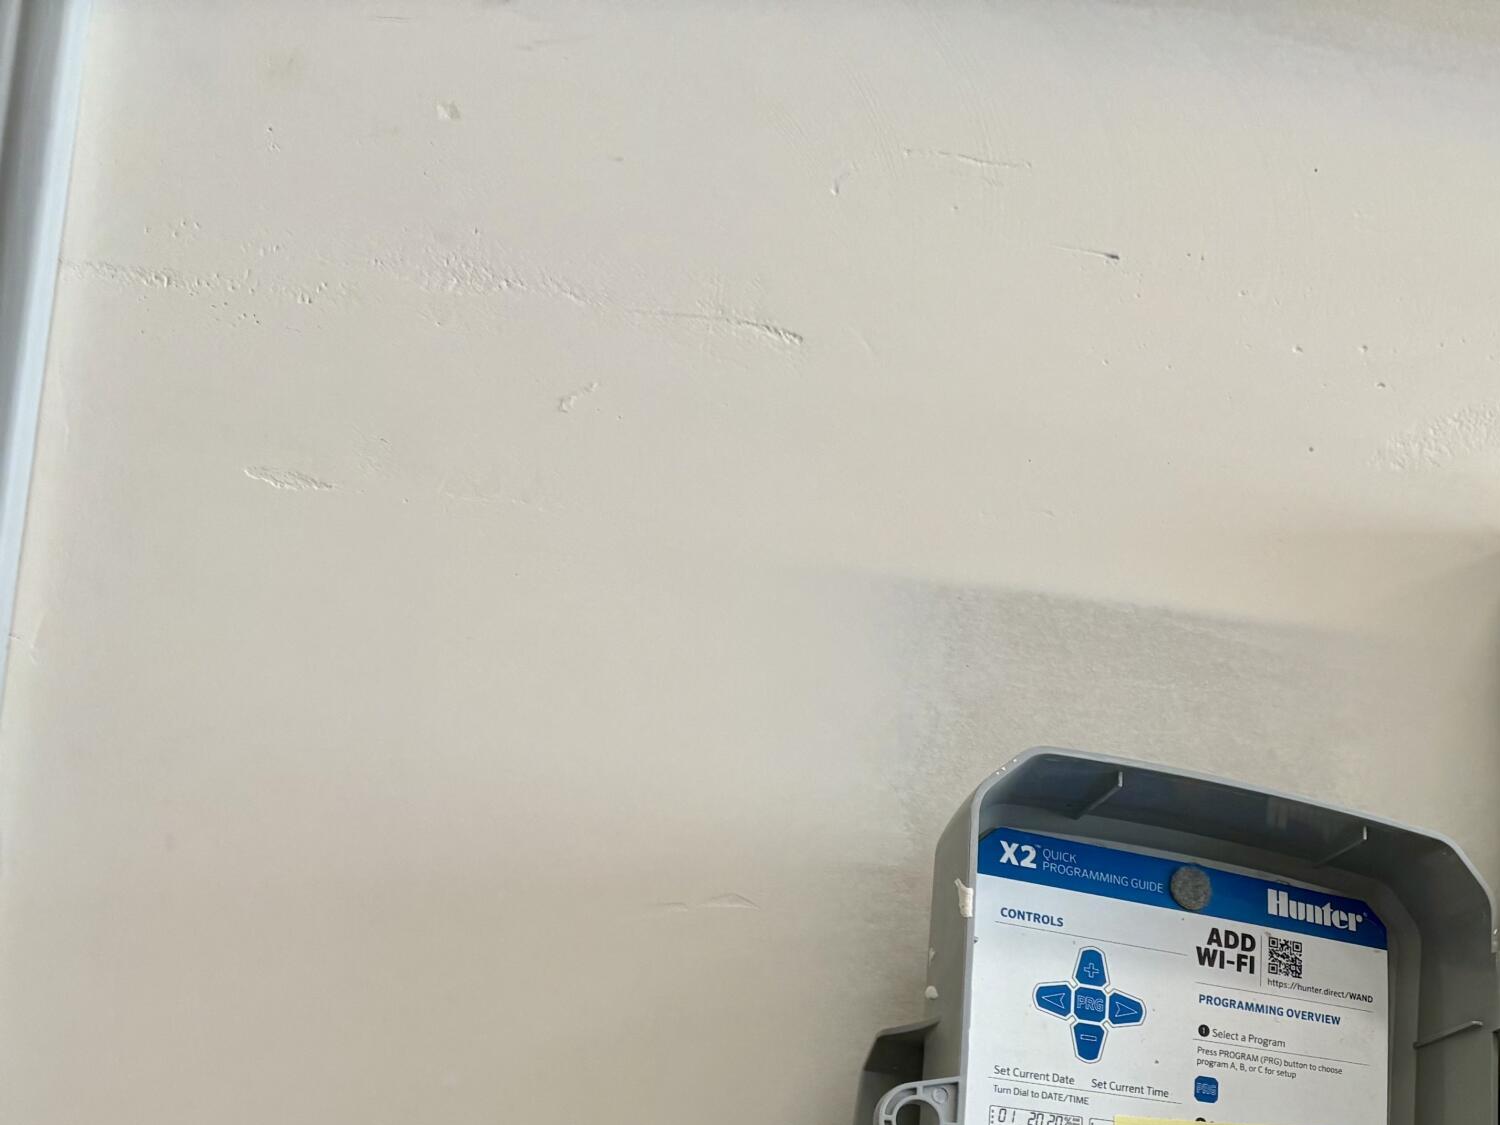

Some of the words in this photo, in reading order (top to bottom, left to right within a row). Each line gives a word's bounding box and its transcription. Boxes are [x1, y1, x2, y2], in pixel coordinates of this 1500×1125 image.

[1042, 849, 1077, 864] QUICK
[1042, 862, 1128, 887] PROGRAMMING
[1131, 878, 1164, 893] GUIDE
[1000, 907, 1064, 927] CONTROLS
[1207, 927, 1256, 952] ADD
[1196, 946, 1255, 975] WI-FI
[1268, 978, 1373, 1003] https://hunter.direct/WAND
[1077, 995, 1104, 1012] PRG
[1199, 994, 1284, 1017] PROGRAMMING
[1286, 1008, 1341, 1026] OVERVIEW
[1212, 1029, 1239, 1041] Select
[1248, 1034, 1286, 1048] Program
[1196, 1058, 1229, 1070] program
[1264, 1067, 1275, 1075] for
[1276, 1070, 1297, 1079] setup
[1197, 1046, 1217, 1056] Press
[1219, 1049, 1259, 1062] PROGRAM
[1260, 1055, 1282, 1067] (PRG)
[1284, 1060, 1307, 1069] button
[1318, 1065, 1343, 1075] choose
[994, 1065, 1011, 1076] Set
[1012, 1068, 1050, 1082] Current
[1052, 1073, 1075, 1085] Date
[993, 1084, 1012, 1094] Turn
[1013, 1087, 1029, 1097] Dial
[1031, 1090, 1039, 1098] to
[1041, 1091, 1089, 1105] DATE/TIME
[1091, 1078, 1107, 1090] Set
[1109, 1081, 1144, 1095] Current
[1147, 1086, 1169, 1098] Time
